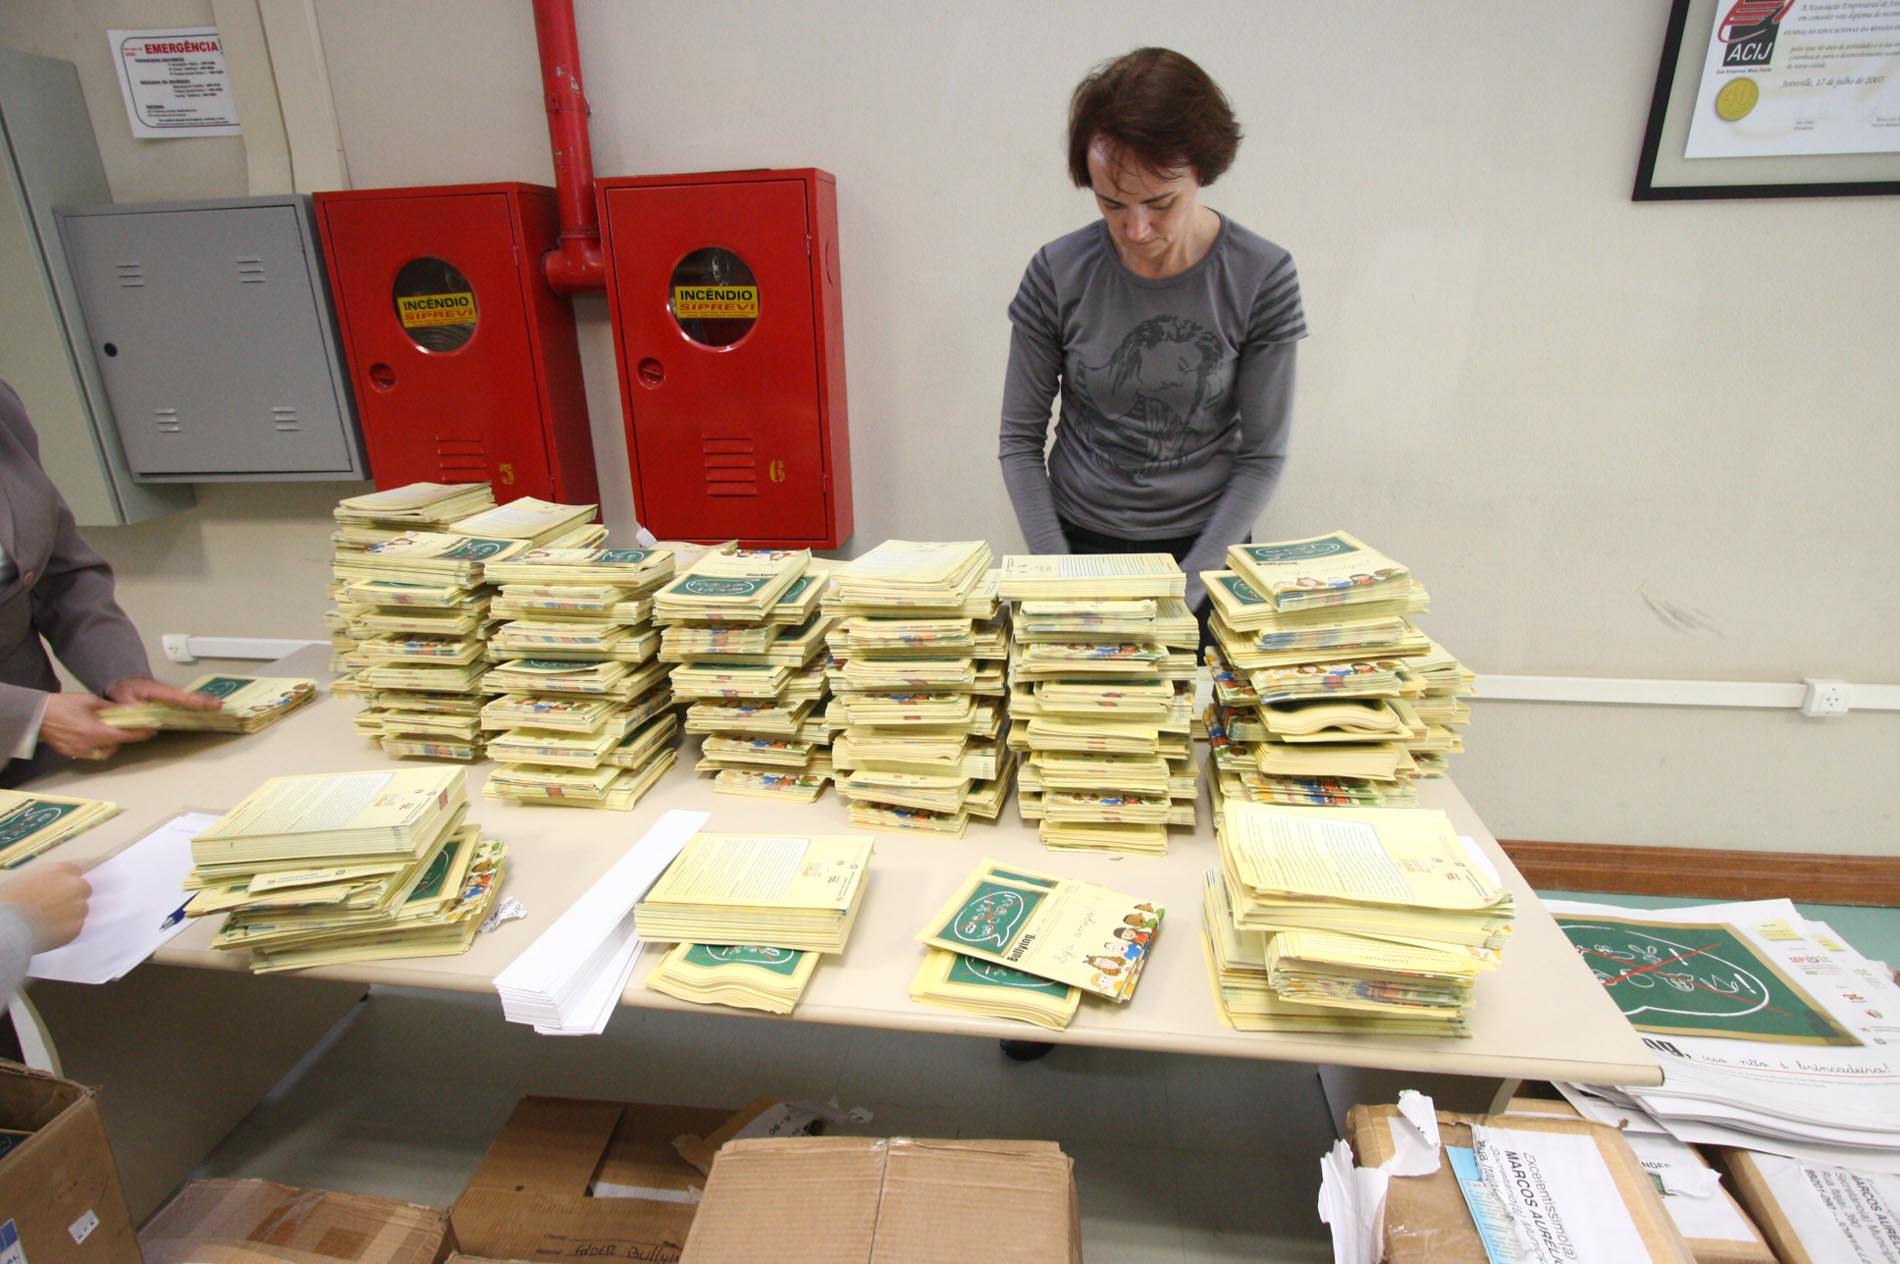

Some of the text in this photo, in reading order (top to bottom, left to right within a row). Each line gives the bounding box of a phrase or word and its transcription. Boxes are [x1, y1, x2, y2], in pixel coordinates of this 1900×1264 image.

[144, 40, 219, 55] EMERGÊNCIA
[1727, 41, 1773, 62] ACIJ
[680, 287, 753, 301] INCÊNDIO
[403, 295, 469, 312] INCÊNDIO
[679, 303, 756, 313] SIPREVI
[405, 309, 473, 322] SIPREVI
[499, 463, 514, 485] 5
[769, 459, 785, 484] 6
[1505, 1150, 1539, 1208] MARCOS
